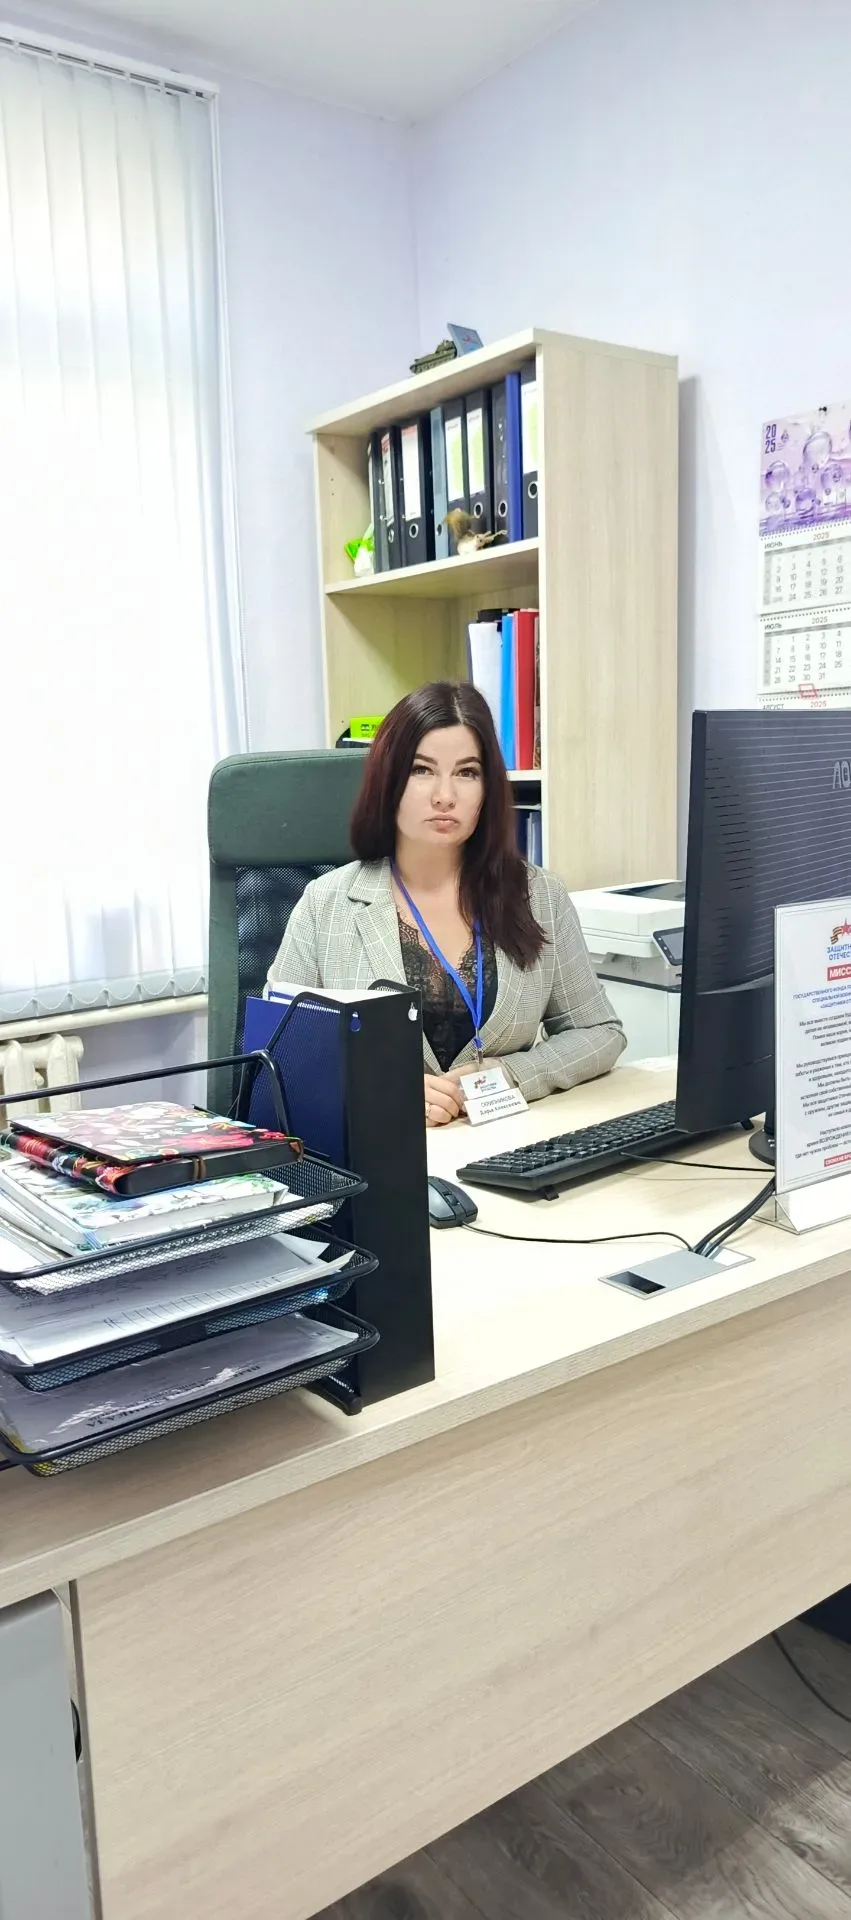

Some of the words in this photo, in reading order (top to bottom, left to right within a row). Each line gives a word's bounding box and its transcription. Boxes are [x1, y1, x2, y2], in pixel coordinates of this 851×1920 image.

[766, 424, 776, 439] 20
[765, 439, 776, 454] 25
[812, 616, 828, 624] 2025
